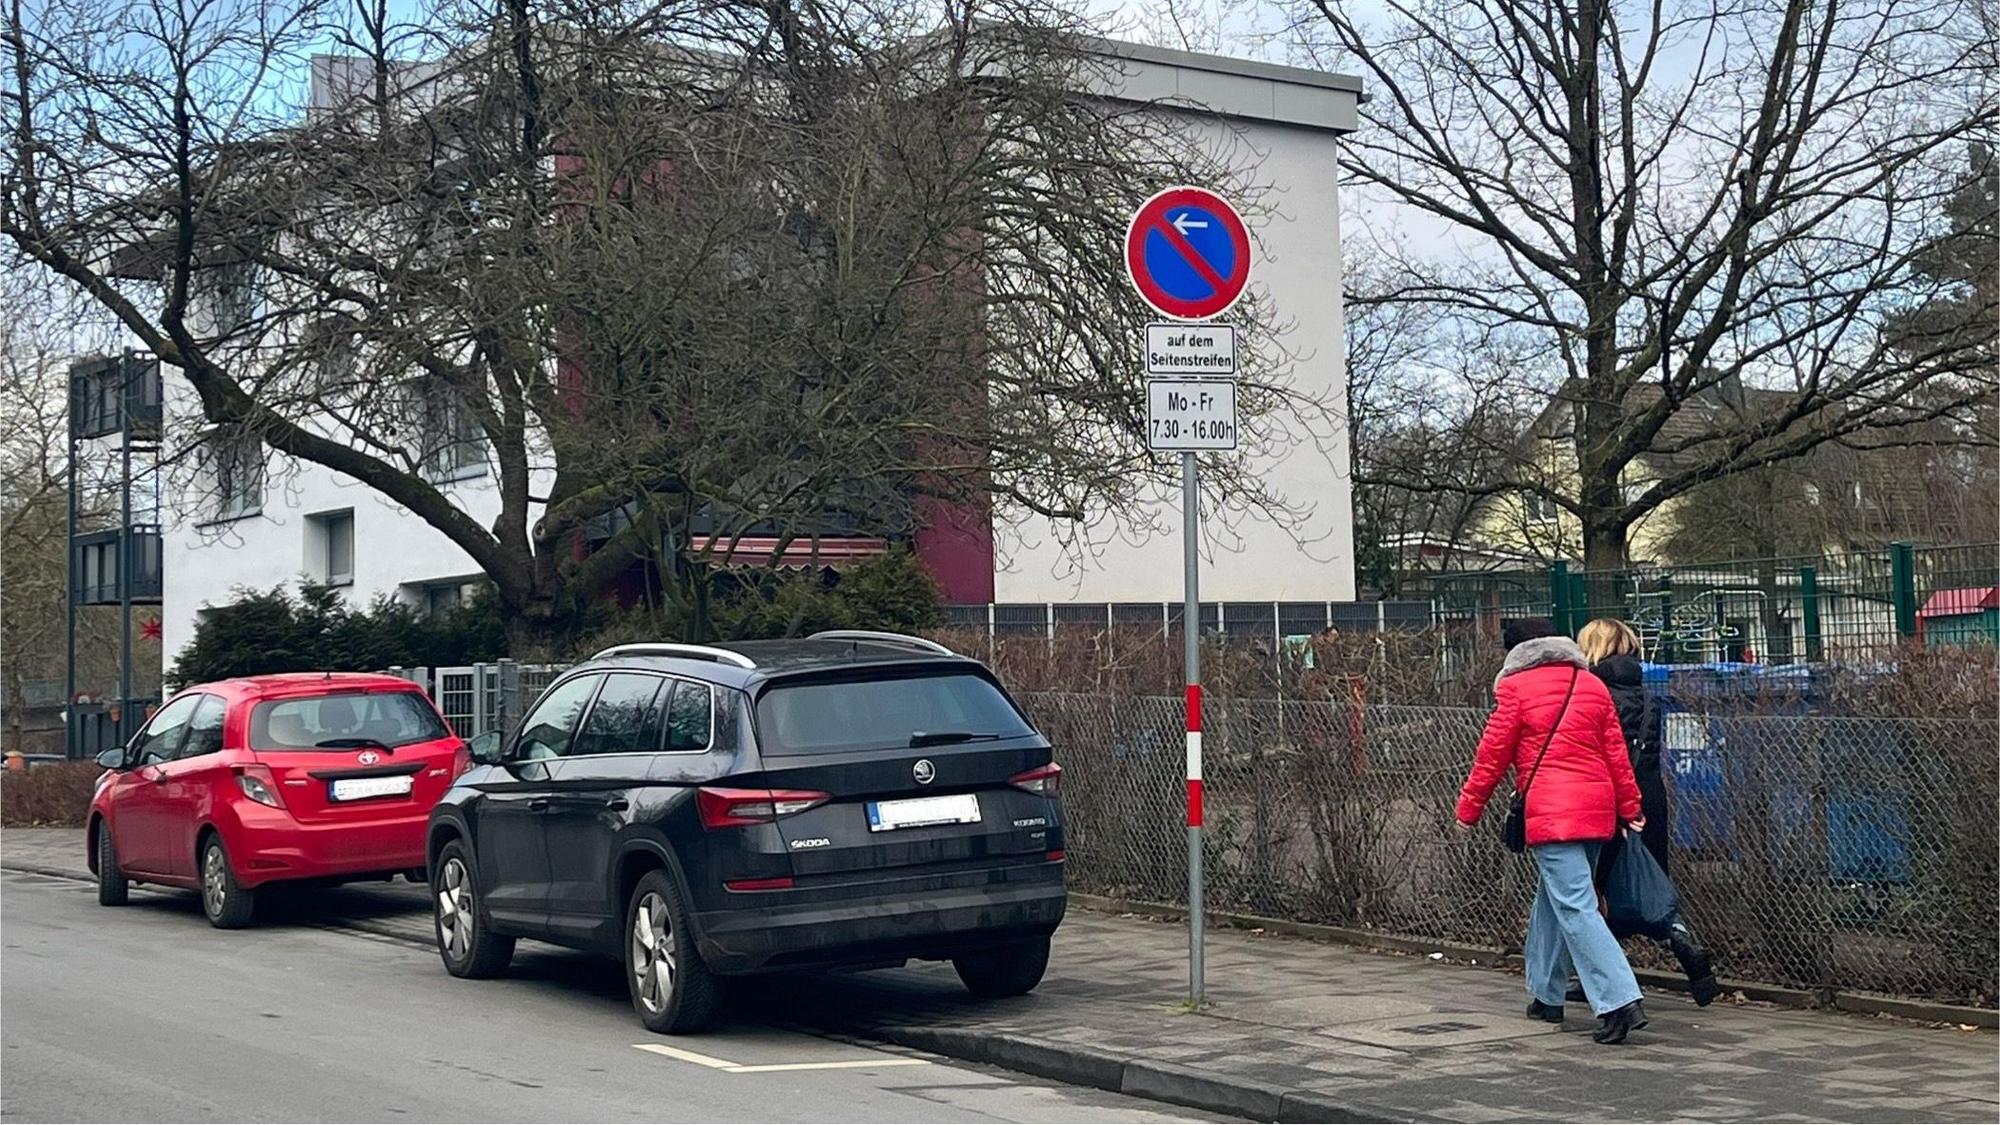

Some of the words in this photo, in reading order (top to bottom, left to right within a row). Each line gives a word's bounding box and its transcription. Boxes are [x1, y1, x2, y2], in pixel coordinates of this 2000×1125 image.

[1167, 334, 1186, 347] auf
[1189, 334, 1213, 347] dem
[1150, 352, 1231, 367] Seitenstreifen
[1168, 392, 1188, 411] Mo
[1200, 392, 1214, 411] Fr
[1152, 419, 1179, 439] 7.30
[1191, 420, 1233, 440] 16.00h
